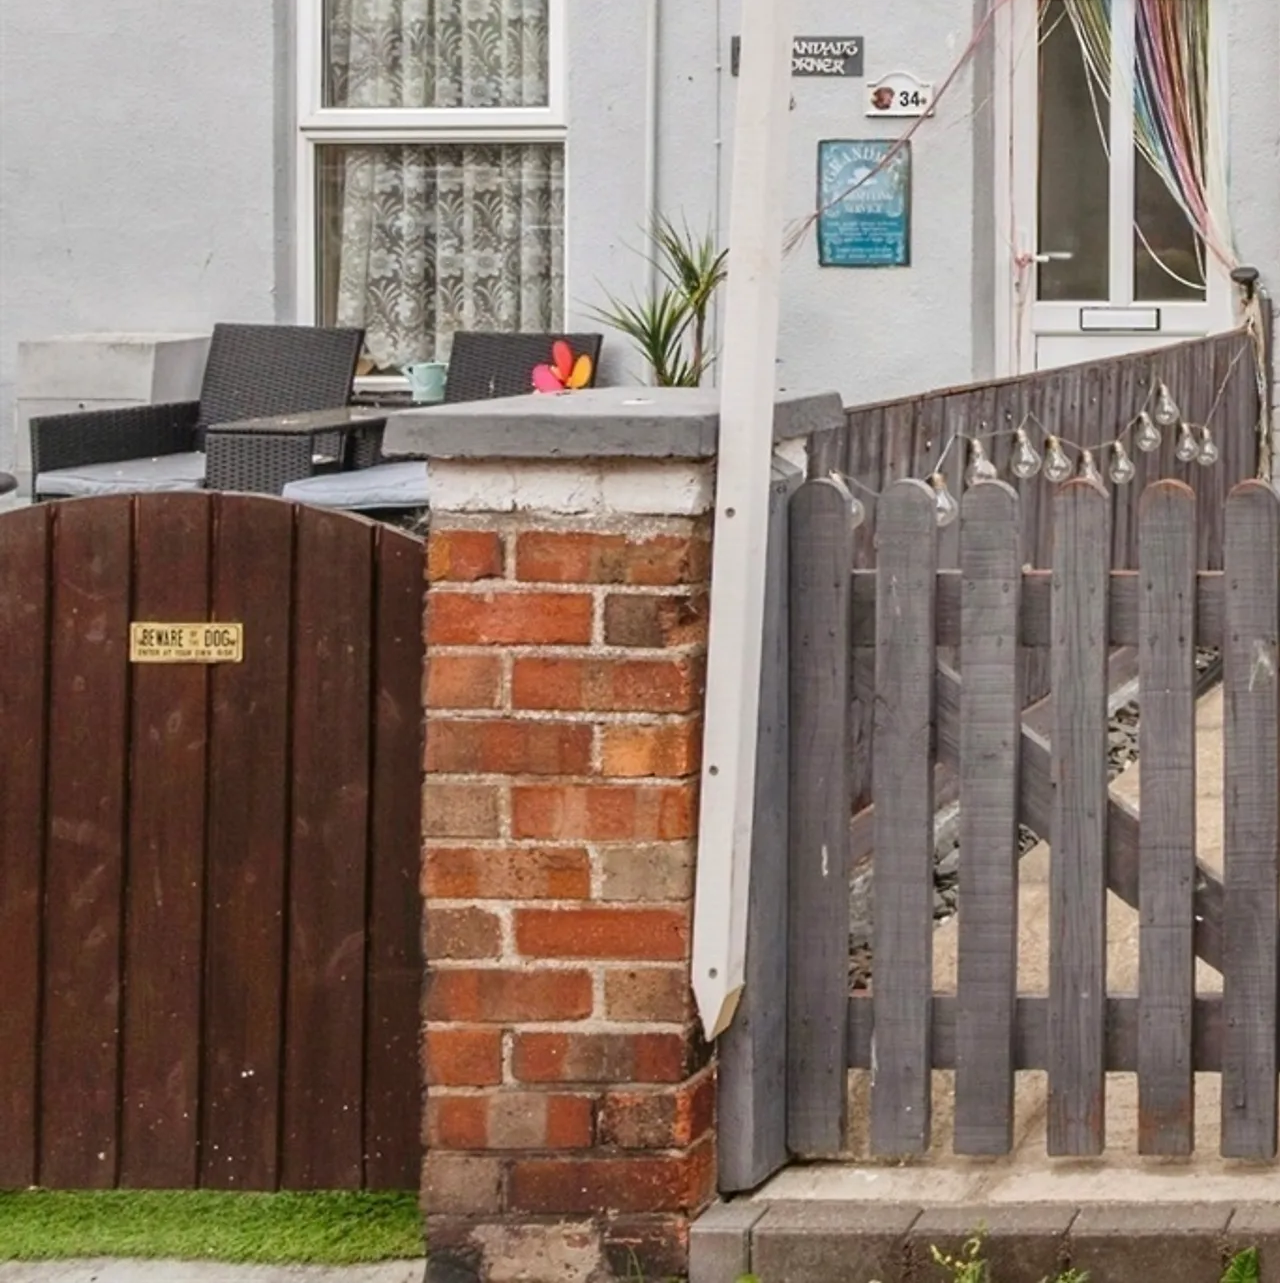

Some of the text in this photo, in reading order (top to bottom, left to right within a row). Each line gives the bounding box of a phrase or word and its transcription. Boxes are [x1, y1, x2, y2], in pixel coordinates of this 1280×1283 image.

[792, 57, 845, 75] ORNER
[142, 628, 184, 648] BEWARE
[204, 628, 231, 648] DOG
